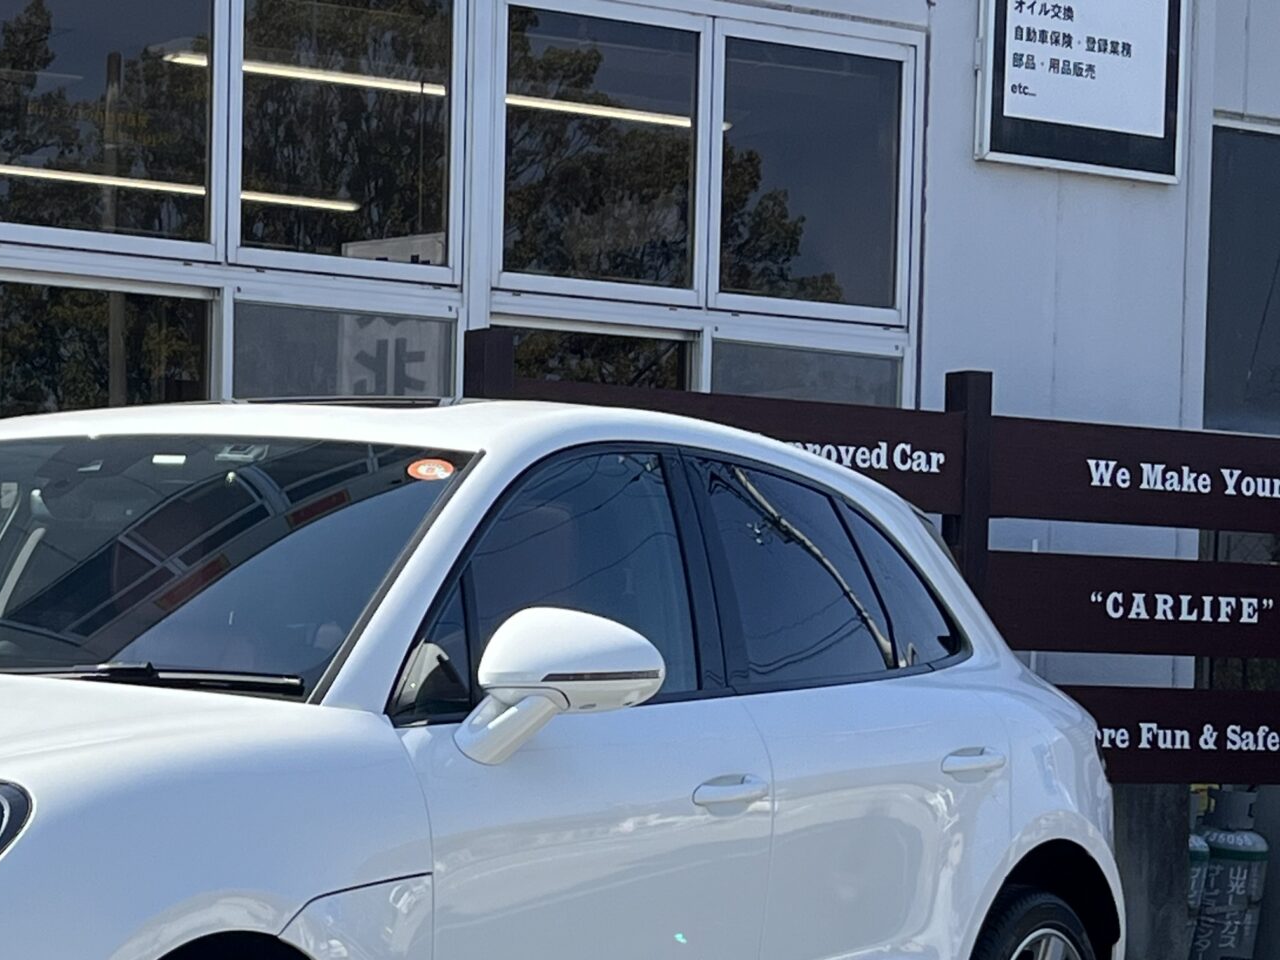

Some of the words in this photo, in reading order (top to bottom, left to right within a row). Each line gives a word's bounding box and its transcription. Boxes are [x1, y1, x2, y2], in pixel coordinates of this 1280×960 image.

[1014, 0, 1074, 22] オイル交換
[893, 442, 946, 473] Car
[1086, 459, 1131, 488] We
[1139, 462, 1212, 494] Make
[1097, 726, 1130, 749] re
[1138, 722, 1191, 750] Fun
[1198, 723, 1218, 750] &
[1226, 724, 1280, 751] Safe
